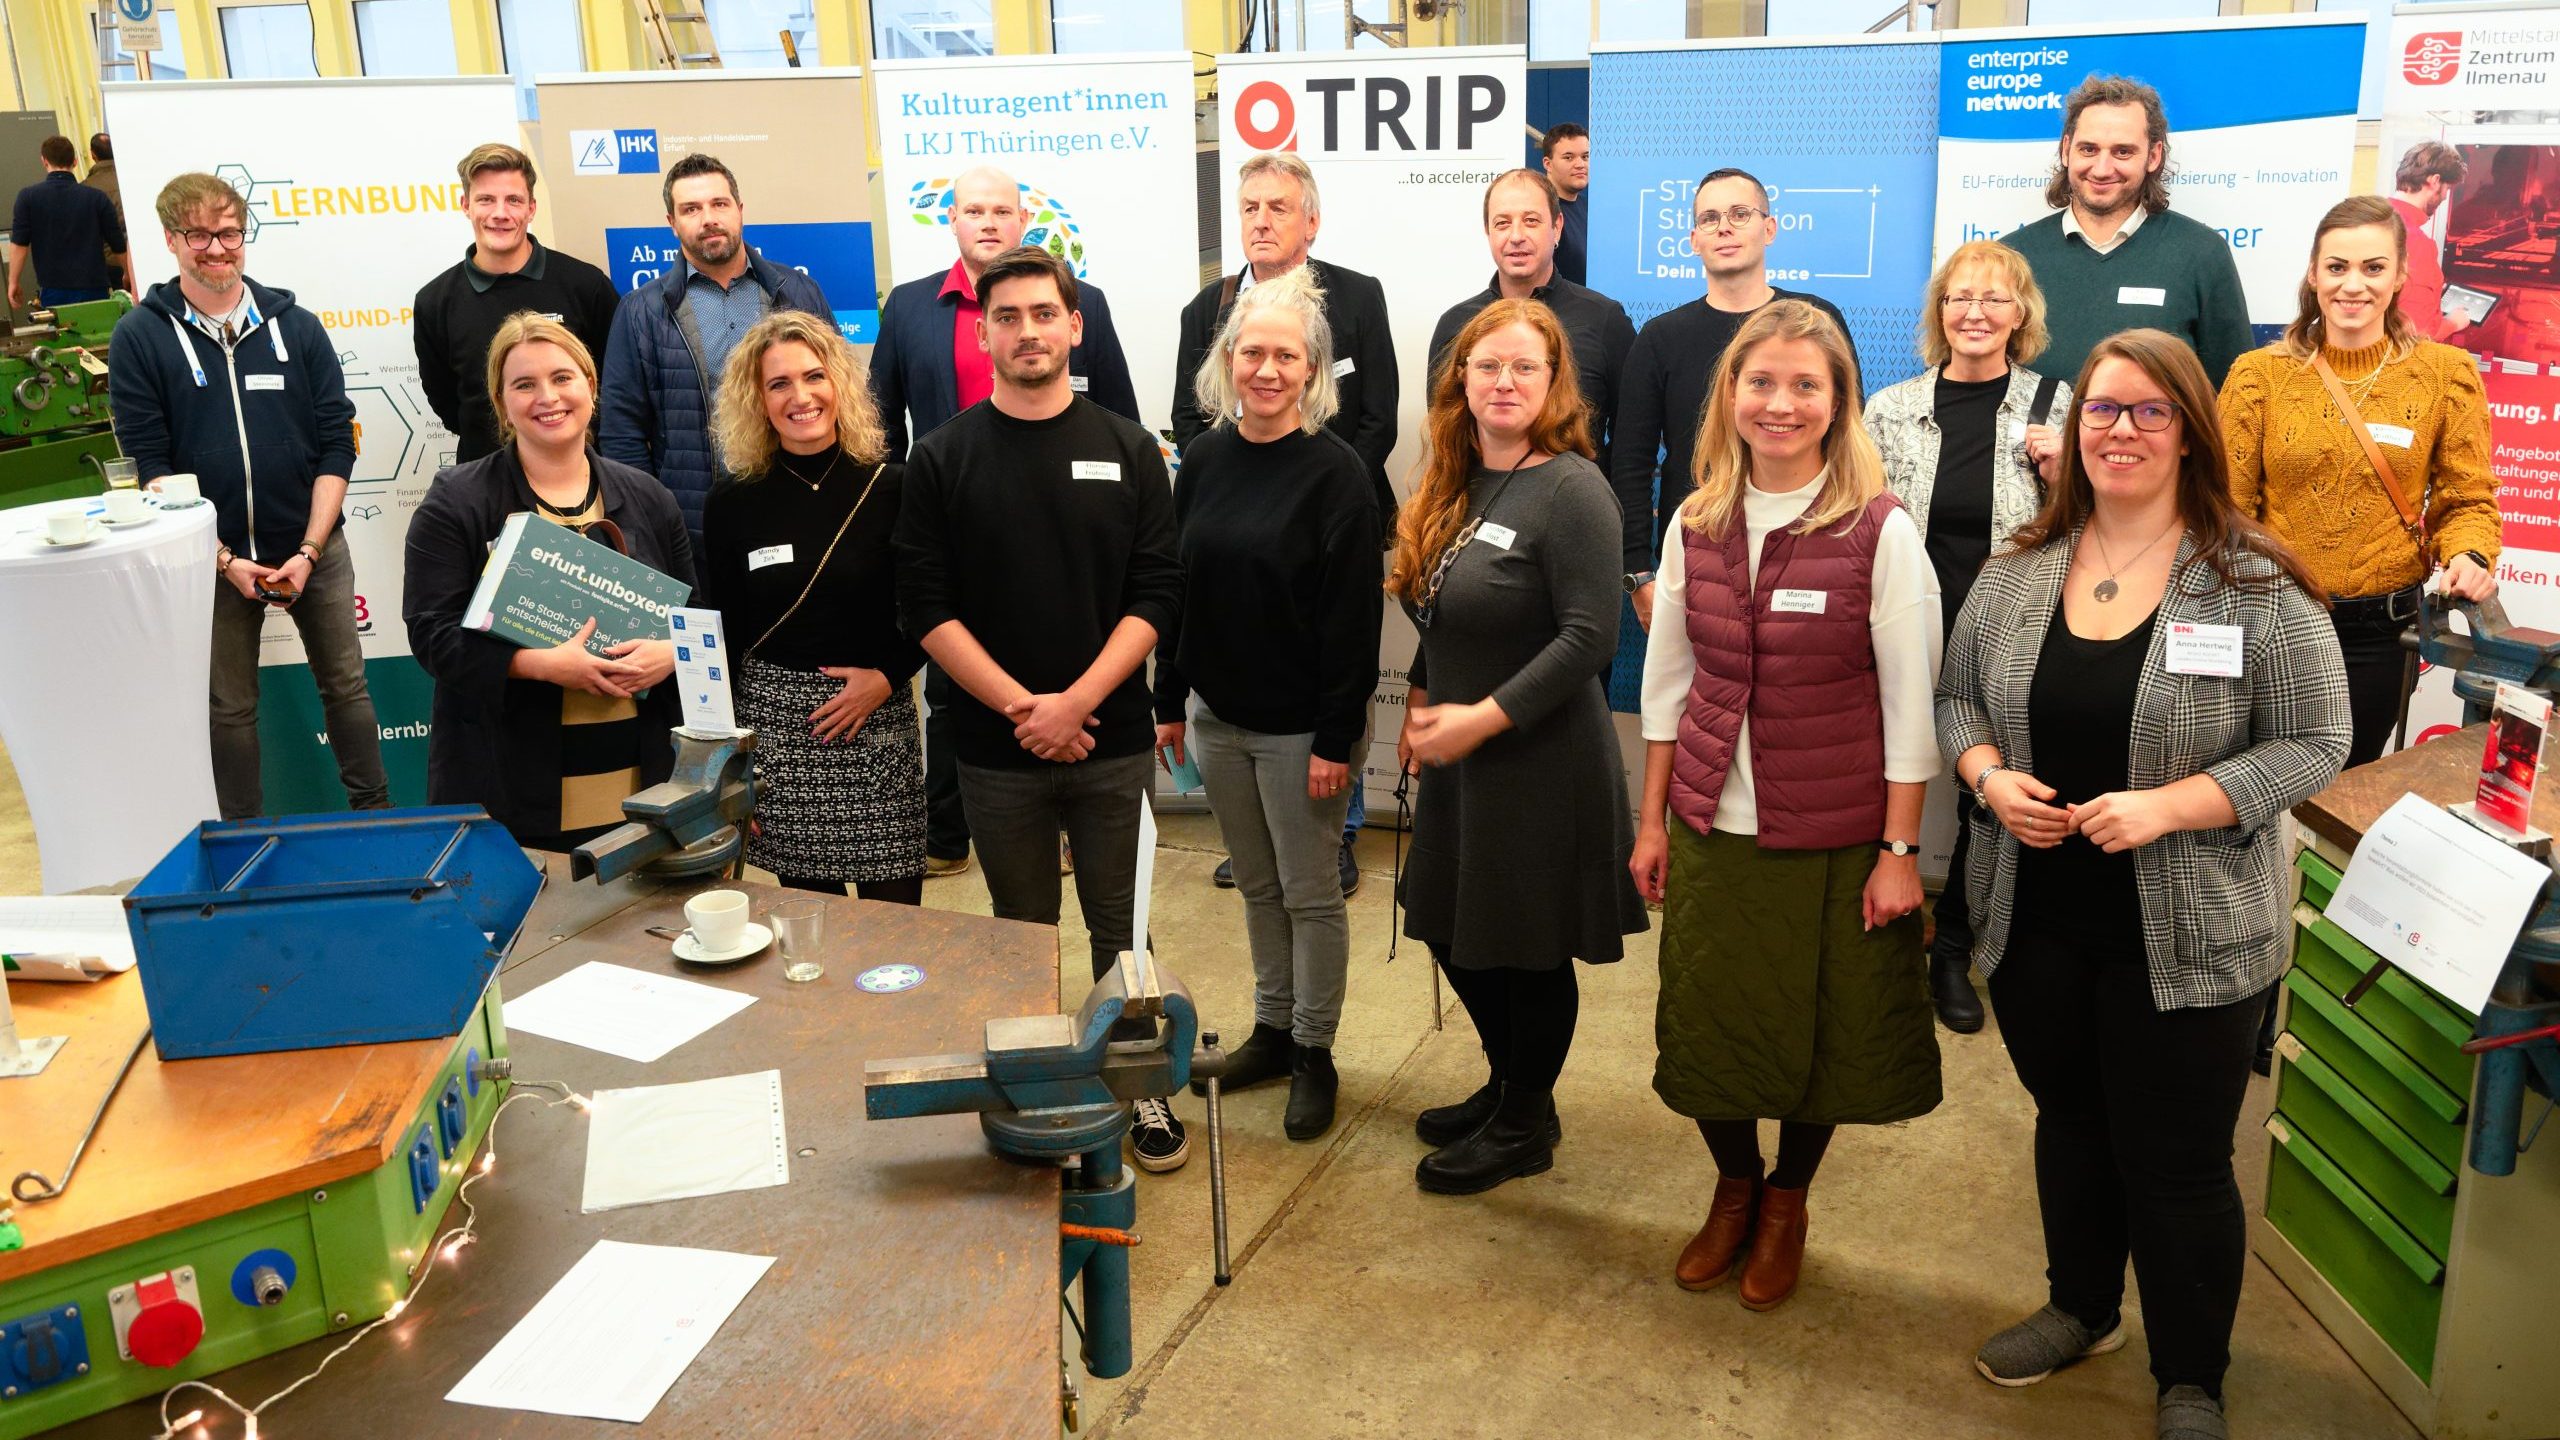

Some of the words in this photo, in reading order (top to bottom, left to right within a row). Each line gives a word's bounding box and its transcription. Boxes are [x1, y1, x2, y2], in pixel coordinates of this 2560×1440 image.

[1968, 46, 2069, 71] enterprise
[2468, 50, 2555, 65] Zentrum
[1967, 73, 2043, 93] europe
[2466, 71, 2546, 85] Ilmenau
[1966, 92, 2062, 112] network
[620, 136, 656, 153] IHK
[664, 144, 685, 152] Erfurt
[904, 132, 953, 155] LKJ
[961, 130, 1103, 157] Thüringen
[1110, 127, 1157, 150] e.V.
[1962, 174, 2052, 189] EU-Förderun
[2256, 168, 2339, 184] Innovation
[630, 247, 657, 263] Ab
[1656, 264, 1696, 279] Dein
[426, 431, 446, 440] oder
[396, 489, 428, 497] Finanzi
[2523, 487, 2554, 501] und
[1785, 591, 1813, 599] Marina
[1780, 600, 1816, 610] Henniger
[505, 604, 572, 639] entscheidest
[518, 595, 536, 610] Die
[594, 629, 612, 643] bei
[2175, 640, 2198, 648] Anna
[2200, 642, 2233, 652] Hertwig
